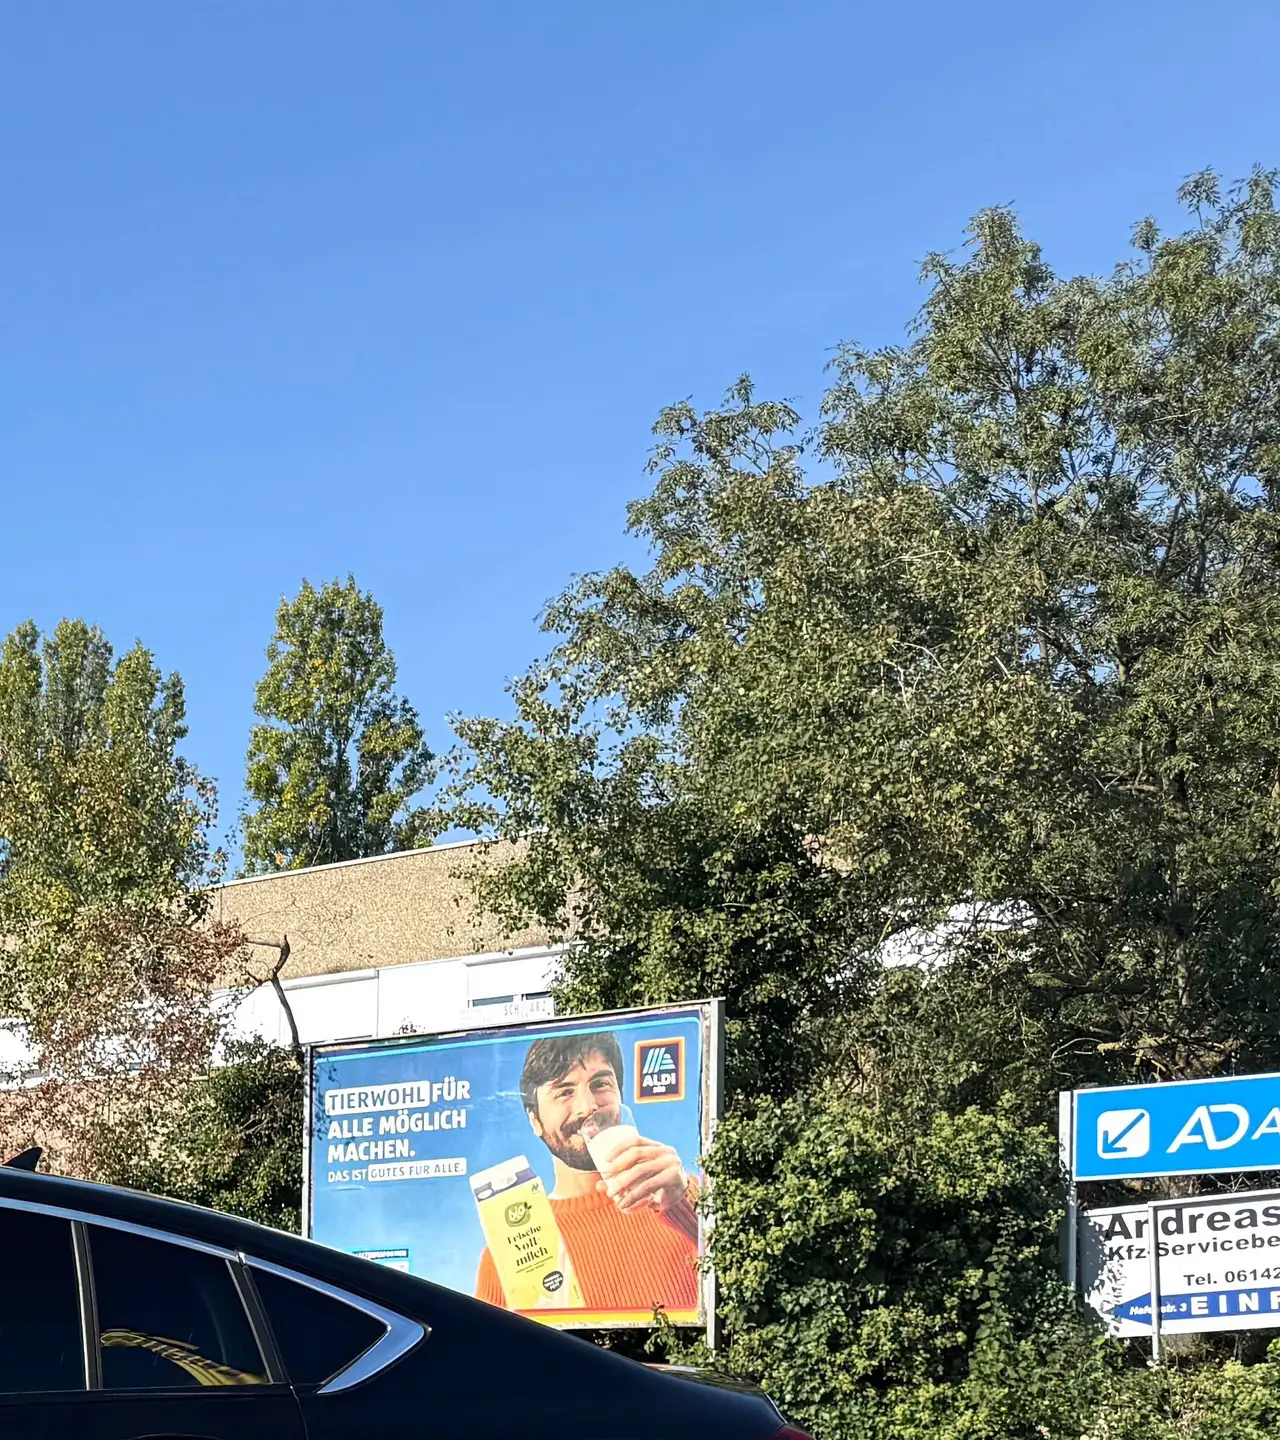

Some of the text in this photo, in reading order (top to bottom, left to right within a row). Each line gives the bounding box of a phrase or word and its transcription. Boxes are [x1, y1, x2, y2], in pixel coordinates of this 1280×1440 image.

[642, 1072, 676, 1088] ALDI
[328, 1076, 471, 1111] TIERWOHL FÜR
[327, 1109, 467, 1140] ALLE MÖGLICH
[1166, 1103, 1280, 1154] ADA
[327, 1138, 416, 1164] MACHEN.
[327, 1170, 350, 1183] DAS
[351, 1169, 368, 1181] IST
[370, 1166, 405, 1179] GUTES
[433, 1161, 464, 1174] ALLE.
[516, 1246, 549, 1267] milch
[1183, 1267, 1280, 1286] Tel. 06142
[1179, 1303, 1187, 1312] 3
